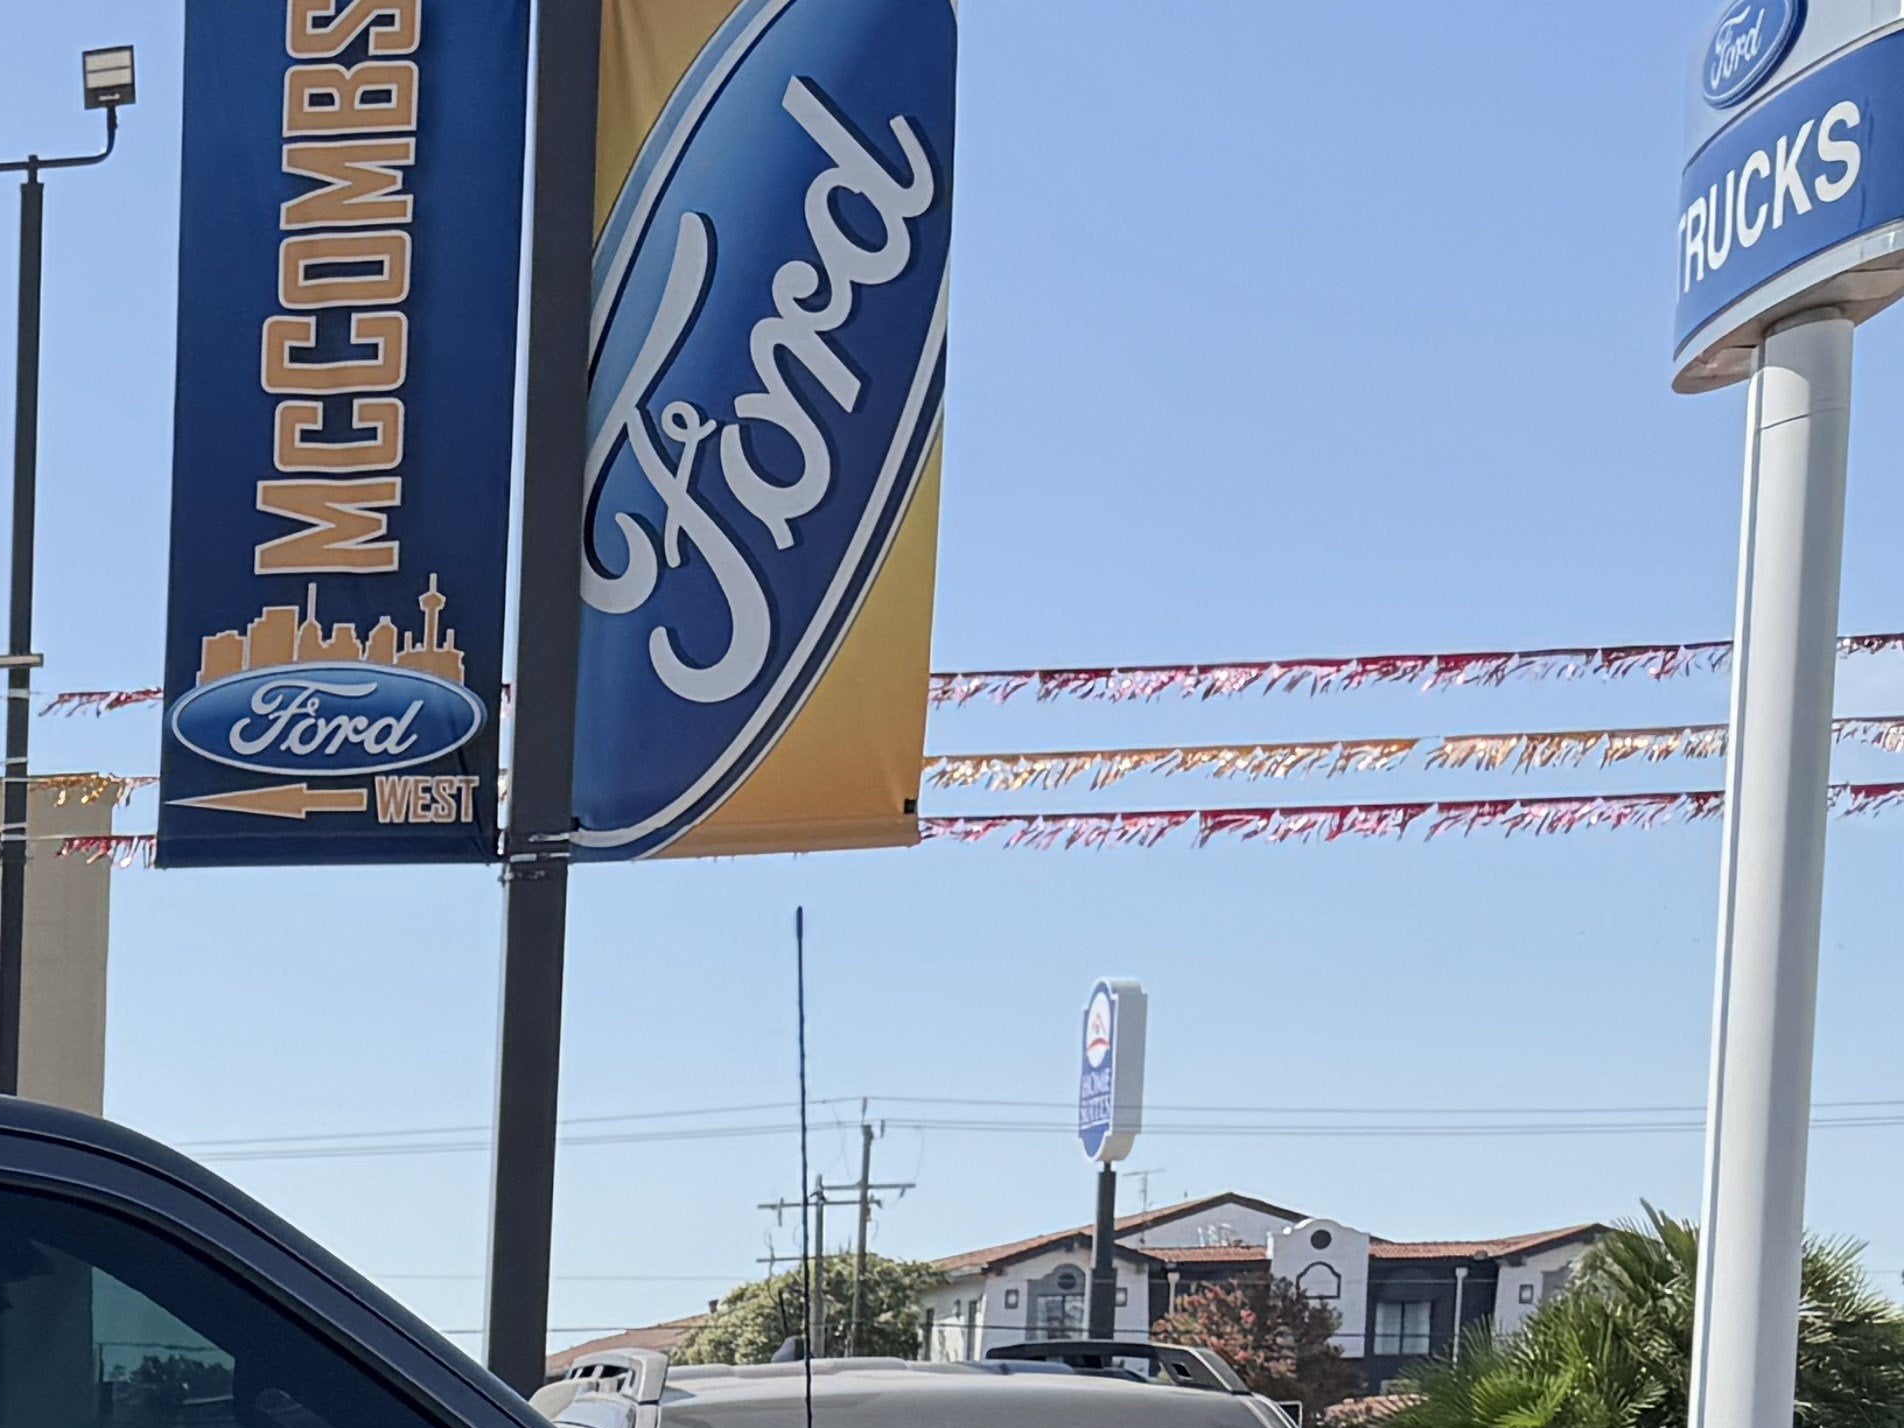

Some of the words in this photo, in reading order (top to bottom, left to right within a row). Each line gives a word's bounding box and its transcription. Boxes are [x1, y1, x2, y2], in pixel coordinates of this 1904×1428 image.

[1710, 5, 1765, 90] Ford
[254, 0, 421, 575] MCCOMBS
[581, 75, 934, 703] Ford
[229, 679, 420, 758] Ford
[375, 775, 480, 824] WEST
